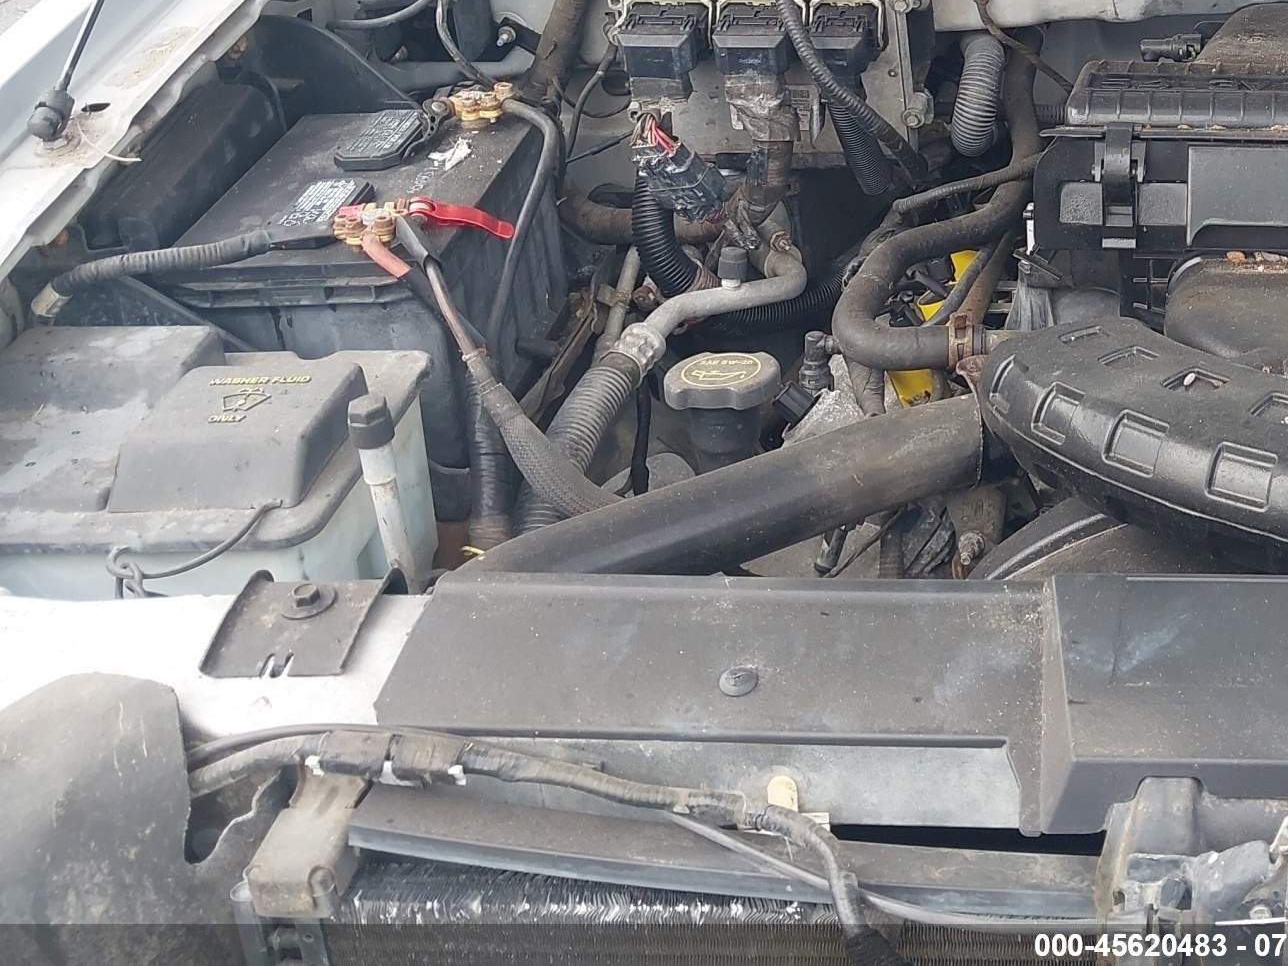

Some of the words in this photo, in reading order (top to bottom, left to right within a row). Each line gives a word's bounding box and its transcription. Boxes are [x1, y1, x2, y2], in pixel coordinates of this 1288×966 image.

[209, 377, 270, 386] WASHER
[272, 375, 312, 384] FLUID
[208, 414, 247, 423] ONLY
